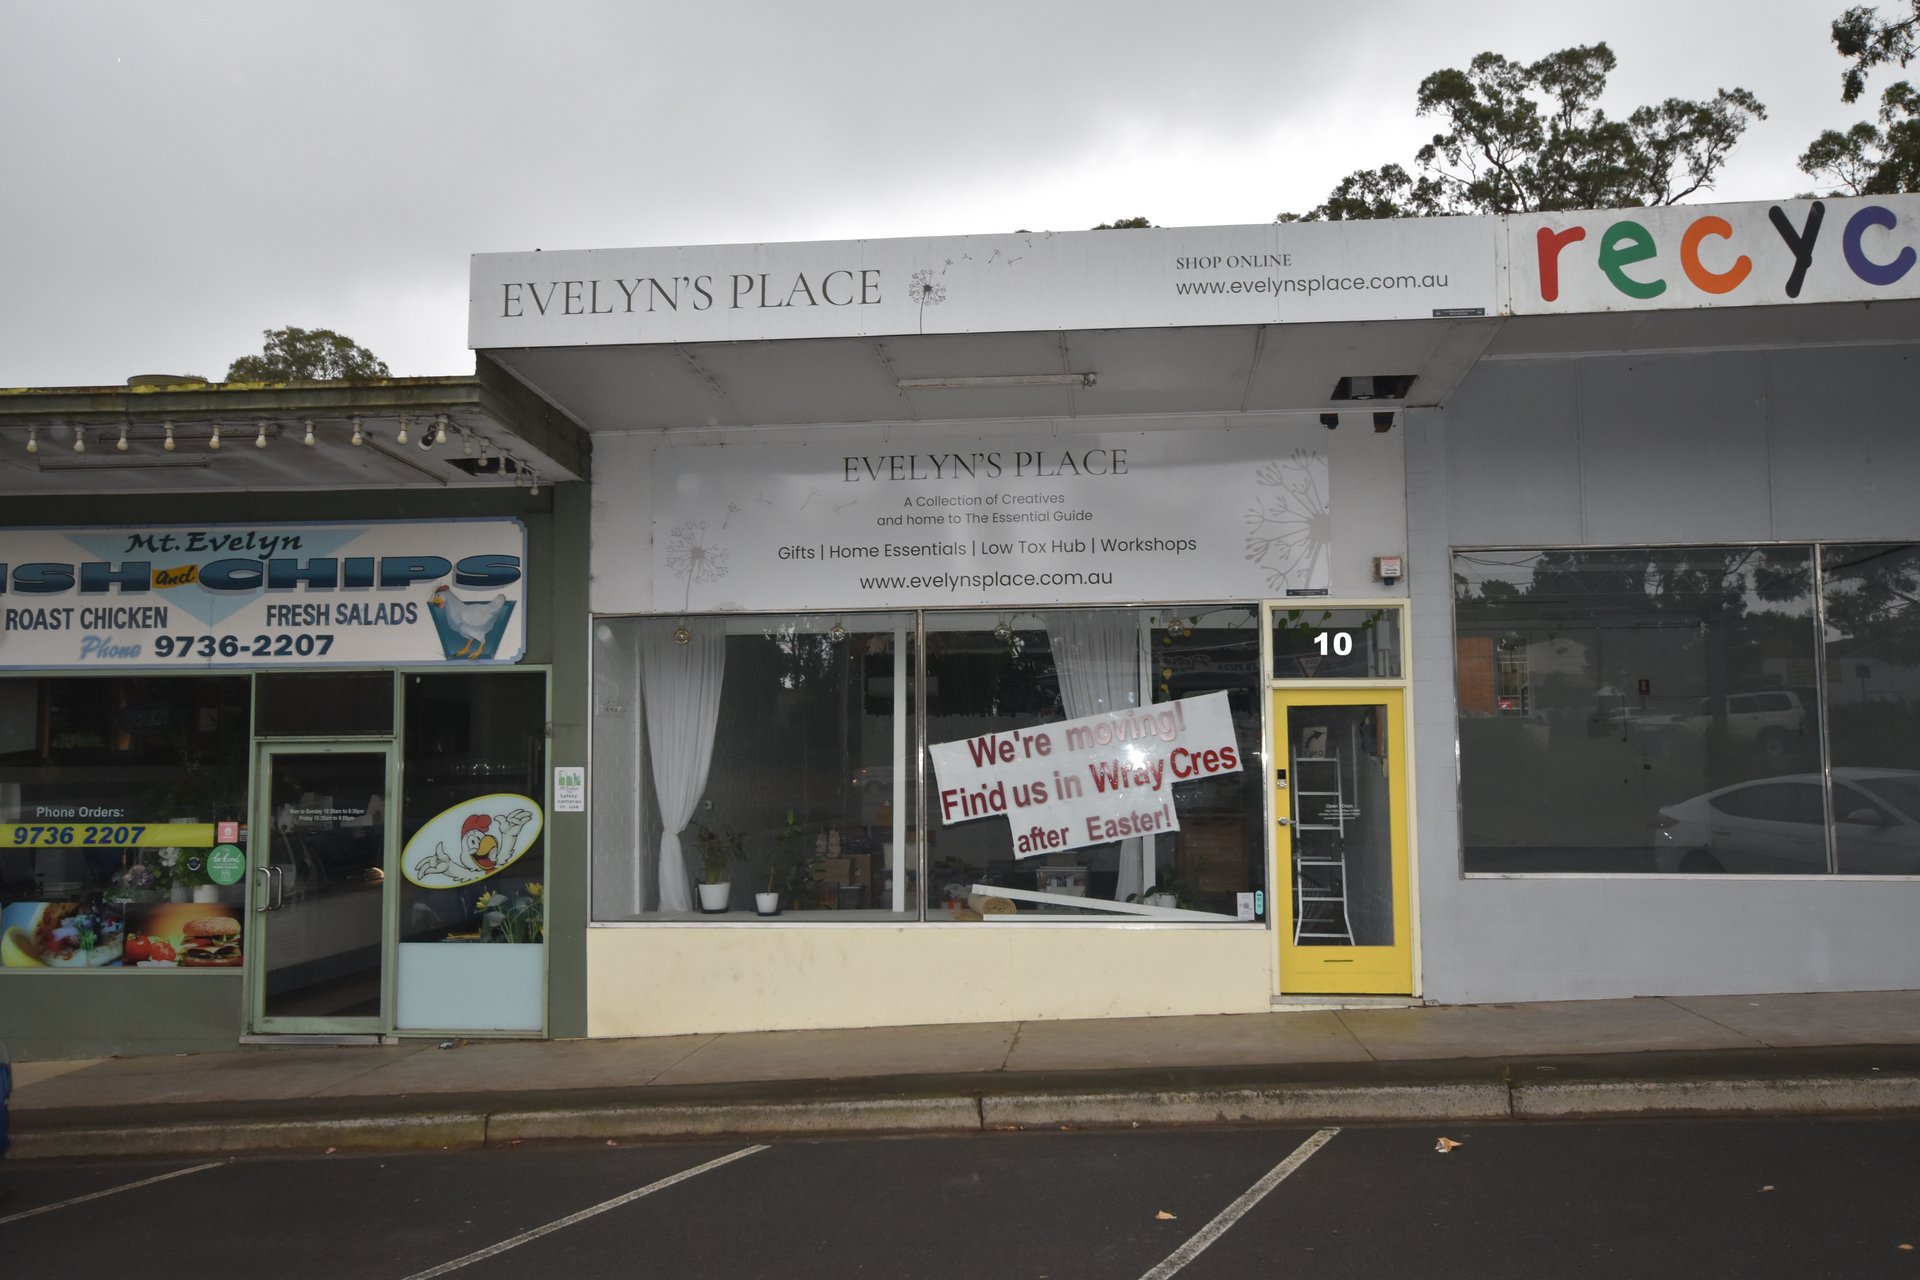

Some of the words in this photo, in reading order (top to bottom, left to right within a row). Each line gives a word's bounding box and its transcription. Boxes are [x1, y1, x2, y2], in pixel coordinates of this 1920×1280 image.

[1177, 257, 1222, 270] SHOP
[1227, 254, 1292, 269] ONLINE
[1537, 201, 1917, 302] recyc
[500, 275, 714, 318] EVELYN'S
[729, 269, 882, 310] PLACE
[1176, 275, 1449, 299] www.evelynsplace.com.au
[842, 451, 1002, 484] EVELYN'S
[1015, 448, 1129, 478] PLACE
[904, 497, 913, 508] A
[916, 494, 983, 507] Collection
[986, 494, 998, 505] of
[1001, 492, 1065, 506] Creatives
[877, 514, 903, 527] and
[906, 514, 944, 526] home
[948, 513, 962, 525] to
[965, 512, 989, 524] The
[992, 511, 1050, 524] Essential
[1054, 509, 1094, 522] Guide
[125, 533, 181, 553] Mt.
[184, 530, 303, 560] Evelyn
[777, 545, 816, 561] Gifts
[829, 545, 880, 559] Home
[884, 541, 967, 558] Essentials
[981, 541, 1014, 555] Low
[1018, 540, 1047, 555] Tox
[1051, 539, 1087, 554] Hub
[1100, 536, 1197, 557] Workshops
[0, 562, 151, 593] SH
[199, 554, 522, 592] CHIPS
[859, 570, 1113, 594] www.evelynsplace.com.au
[5, 607, 75, 631] ROAST
[80, 605, 169, 631] CHICKEN
[266, 603, 331, 628] FRESH
[335, 601, 418, 626] SALADS
[79, 633, 143, 661] Phone
[154, 634, 335, 659] 9736-2207
[1313, 631, 1353, 656] 10
[967, 731, 1053, 768] We're
[1066, 700, 1187, 752] moving!
[941, 781, 1008, 820] Find
[1012, 780, 1049, 808] us
[1053, 769, 1083, 801] in
[1089, 757, 1164, 794] Wray
[1169, 745, 1239, 779] Cres
[36, 806, 75, 818] Phone
[79, 805, 124, 818] Orders:
[13, 826, 75, 845] 9736
[83, 826, 146, 844] 2207
[1017, 825, 1070, 854] after
[1086, 803, 1172, 842] Easter!
